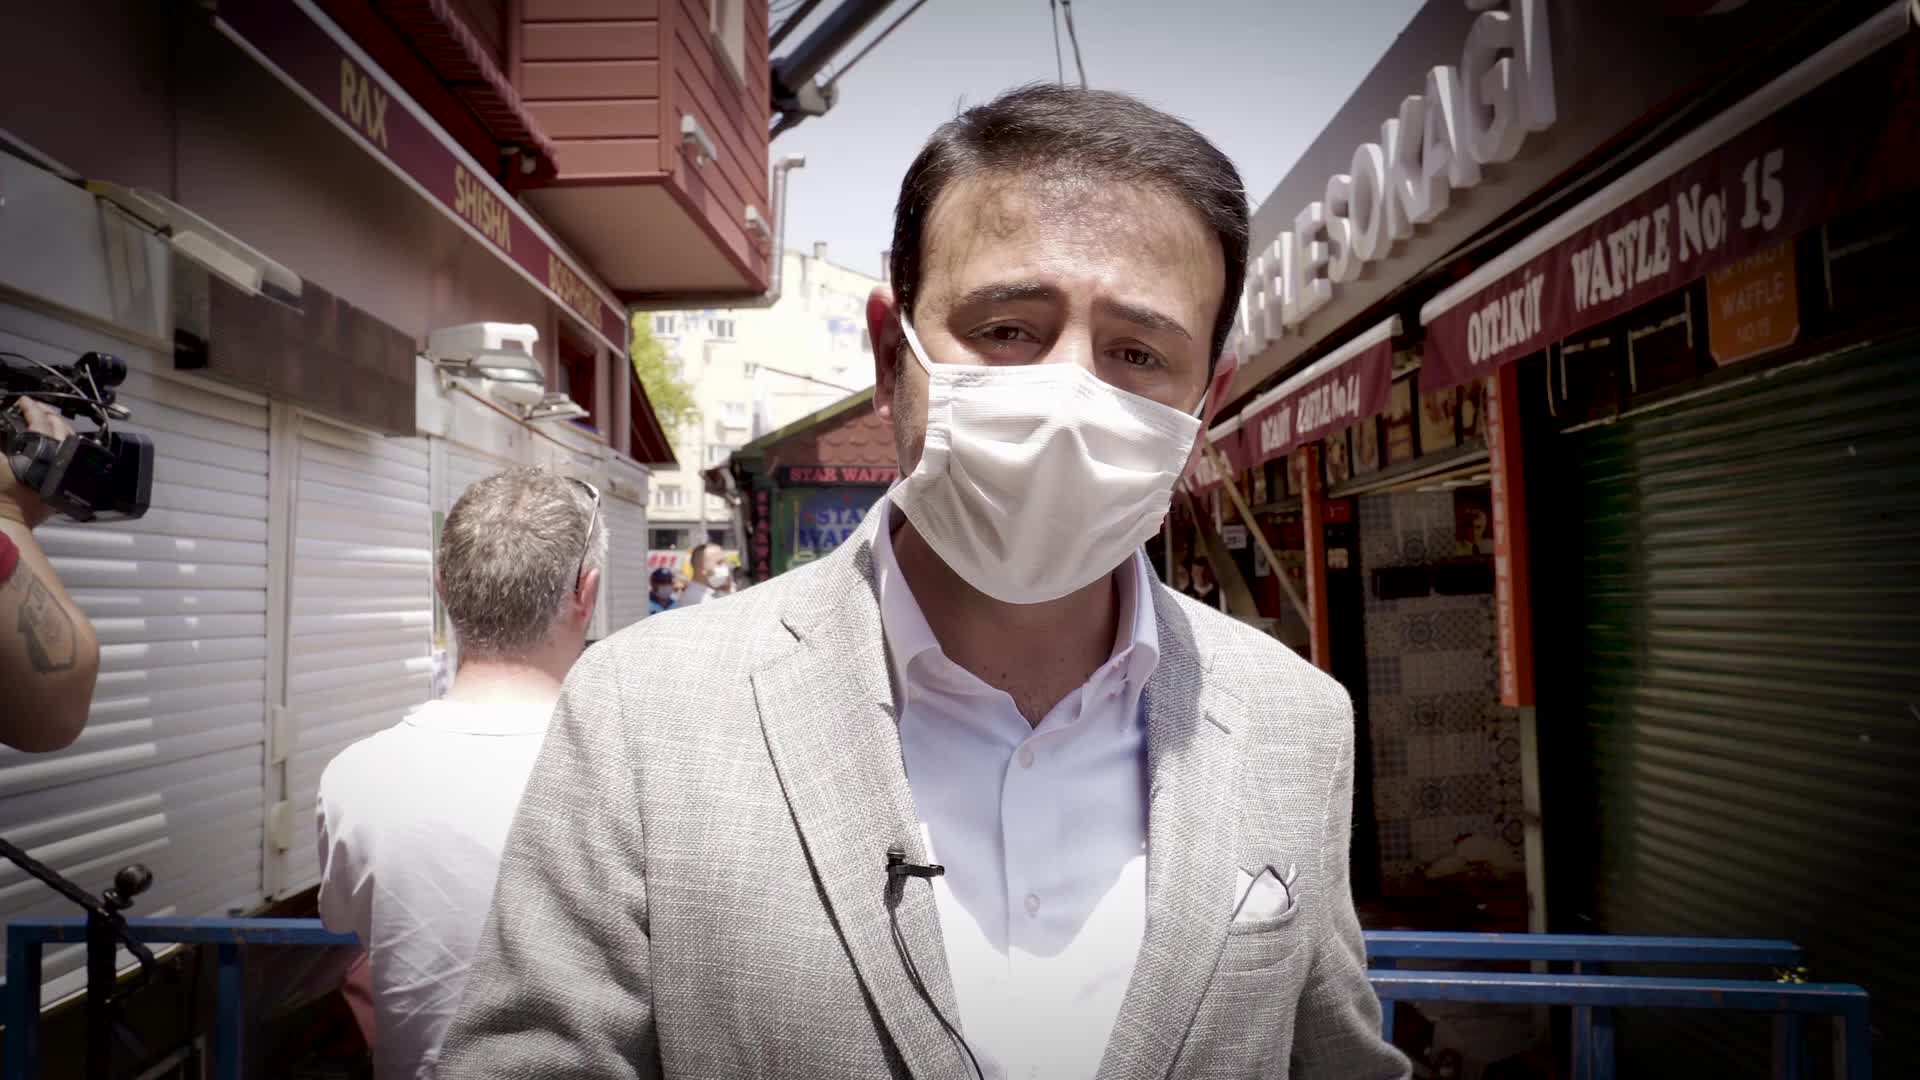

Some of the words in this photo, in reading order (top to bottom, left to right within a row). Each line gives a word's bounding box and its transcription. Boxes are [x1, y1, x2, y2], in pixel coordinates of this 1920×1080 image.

[454, 164, 513, 252] SHISHA
[1571, 205, 1670, 313] WAFFLE
[1740, 148, 1785, 232] 15
[789, 466, 838, 482] STAR
[815, 506, 864, 526] STA
